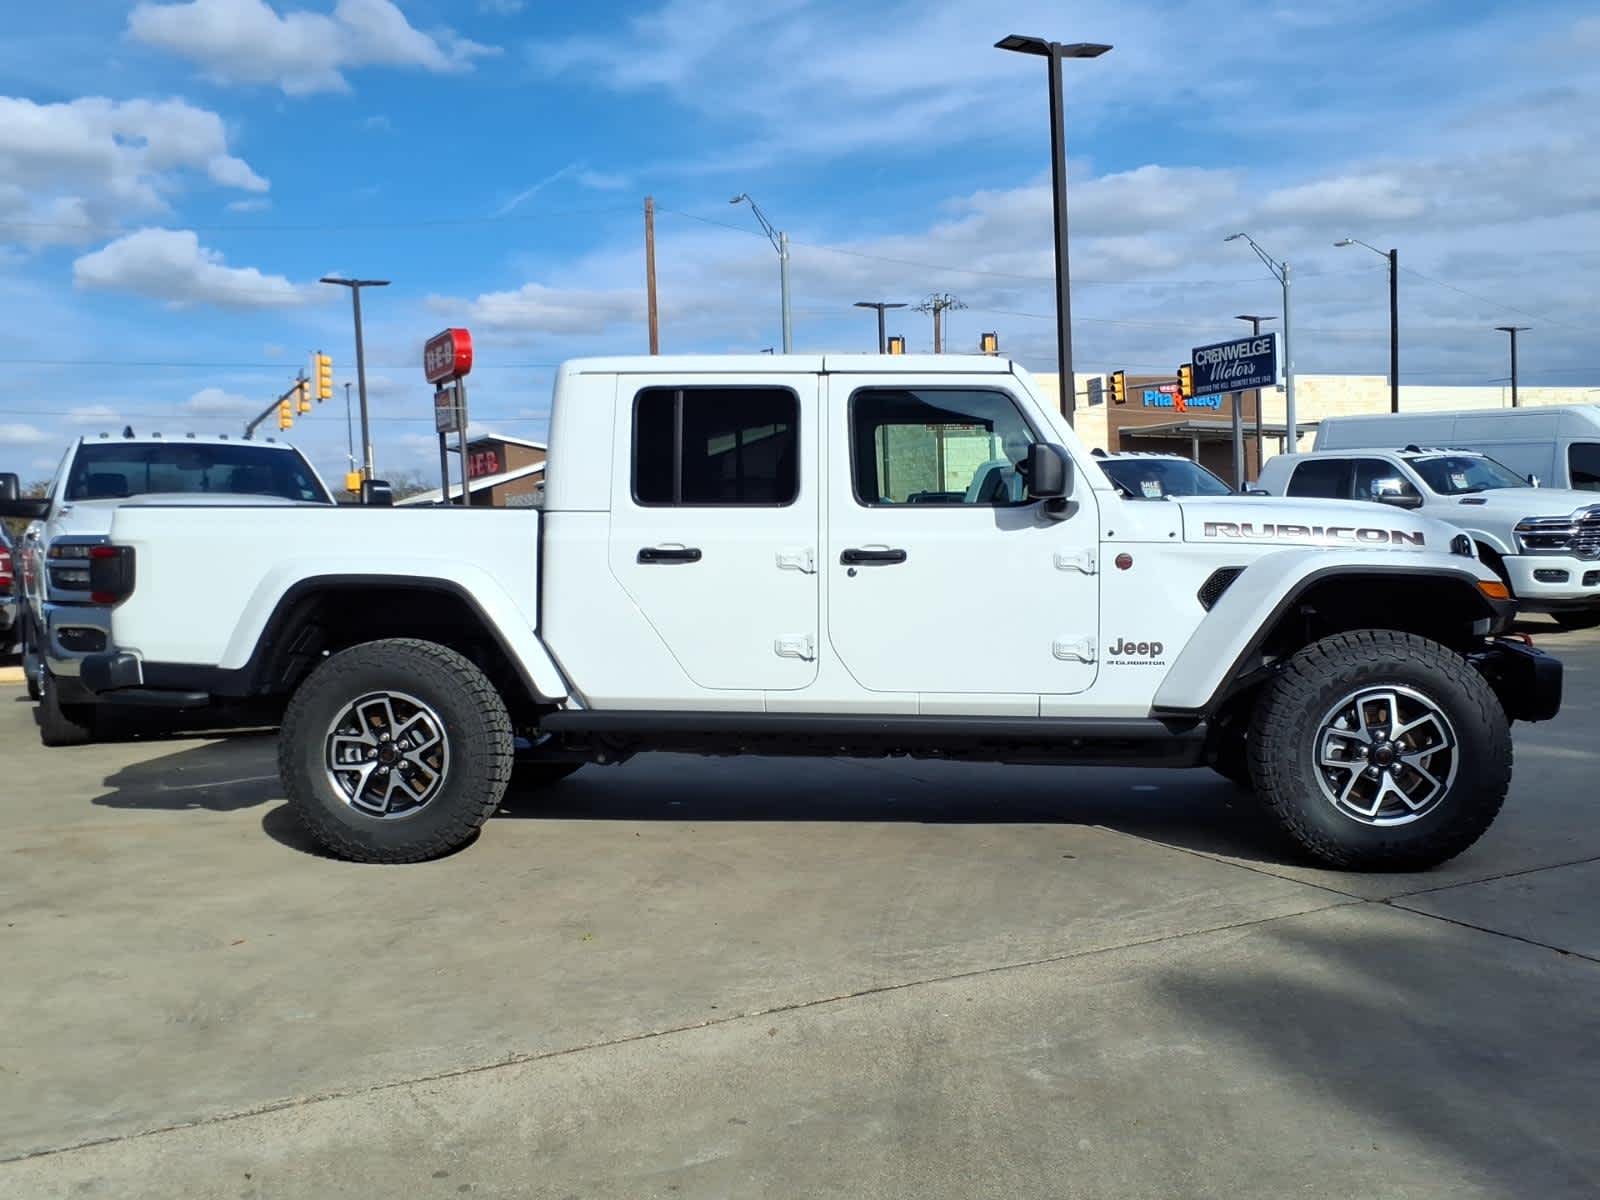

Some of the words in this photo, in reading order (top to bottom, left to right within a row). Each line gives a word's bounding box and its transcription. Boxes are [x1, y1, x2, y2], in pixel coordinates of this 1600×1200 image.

[1195, 339, 1271, 366] CRENWELGE
[1210, 360, 1256, 381] Motors
[1203, 521, 1425, 546] RUBICON
[1109, 637, 1164, 658] Jeep
